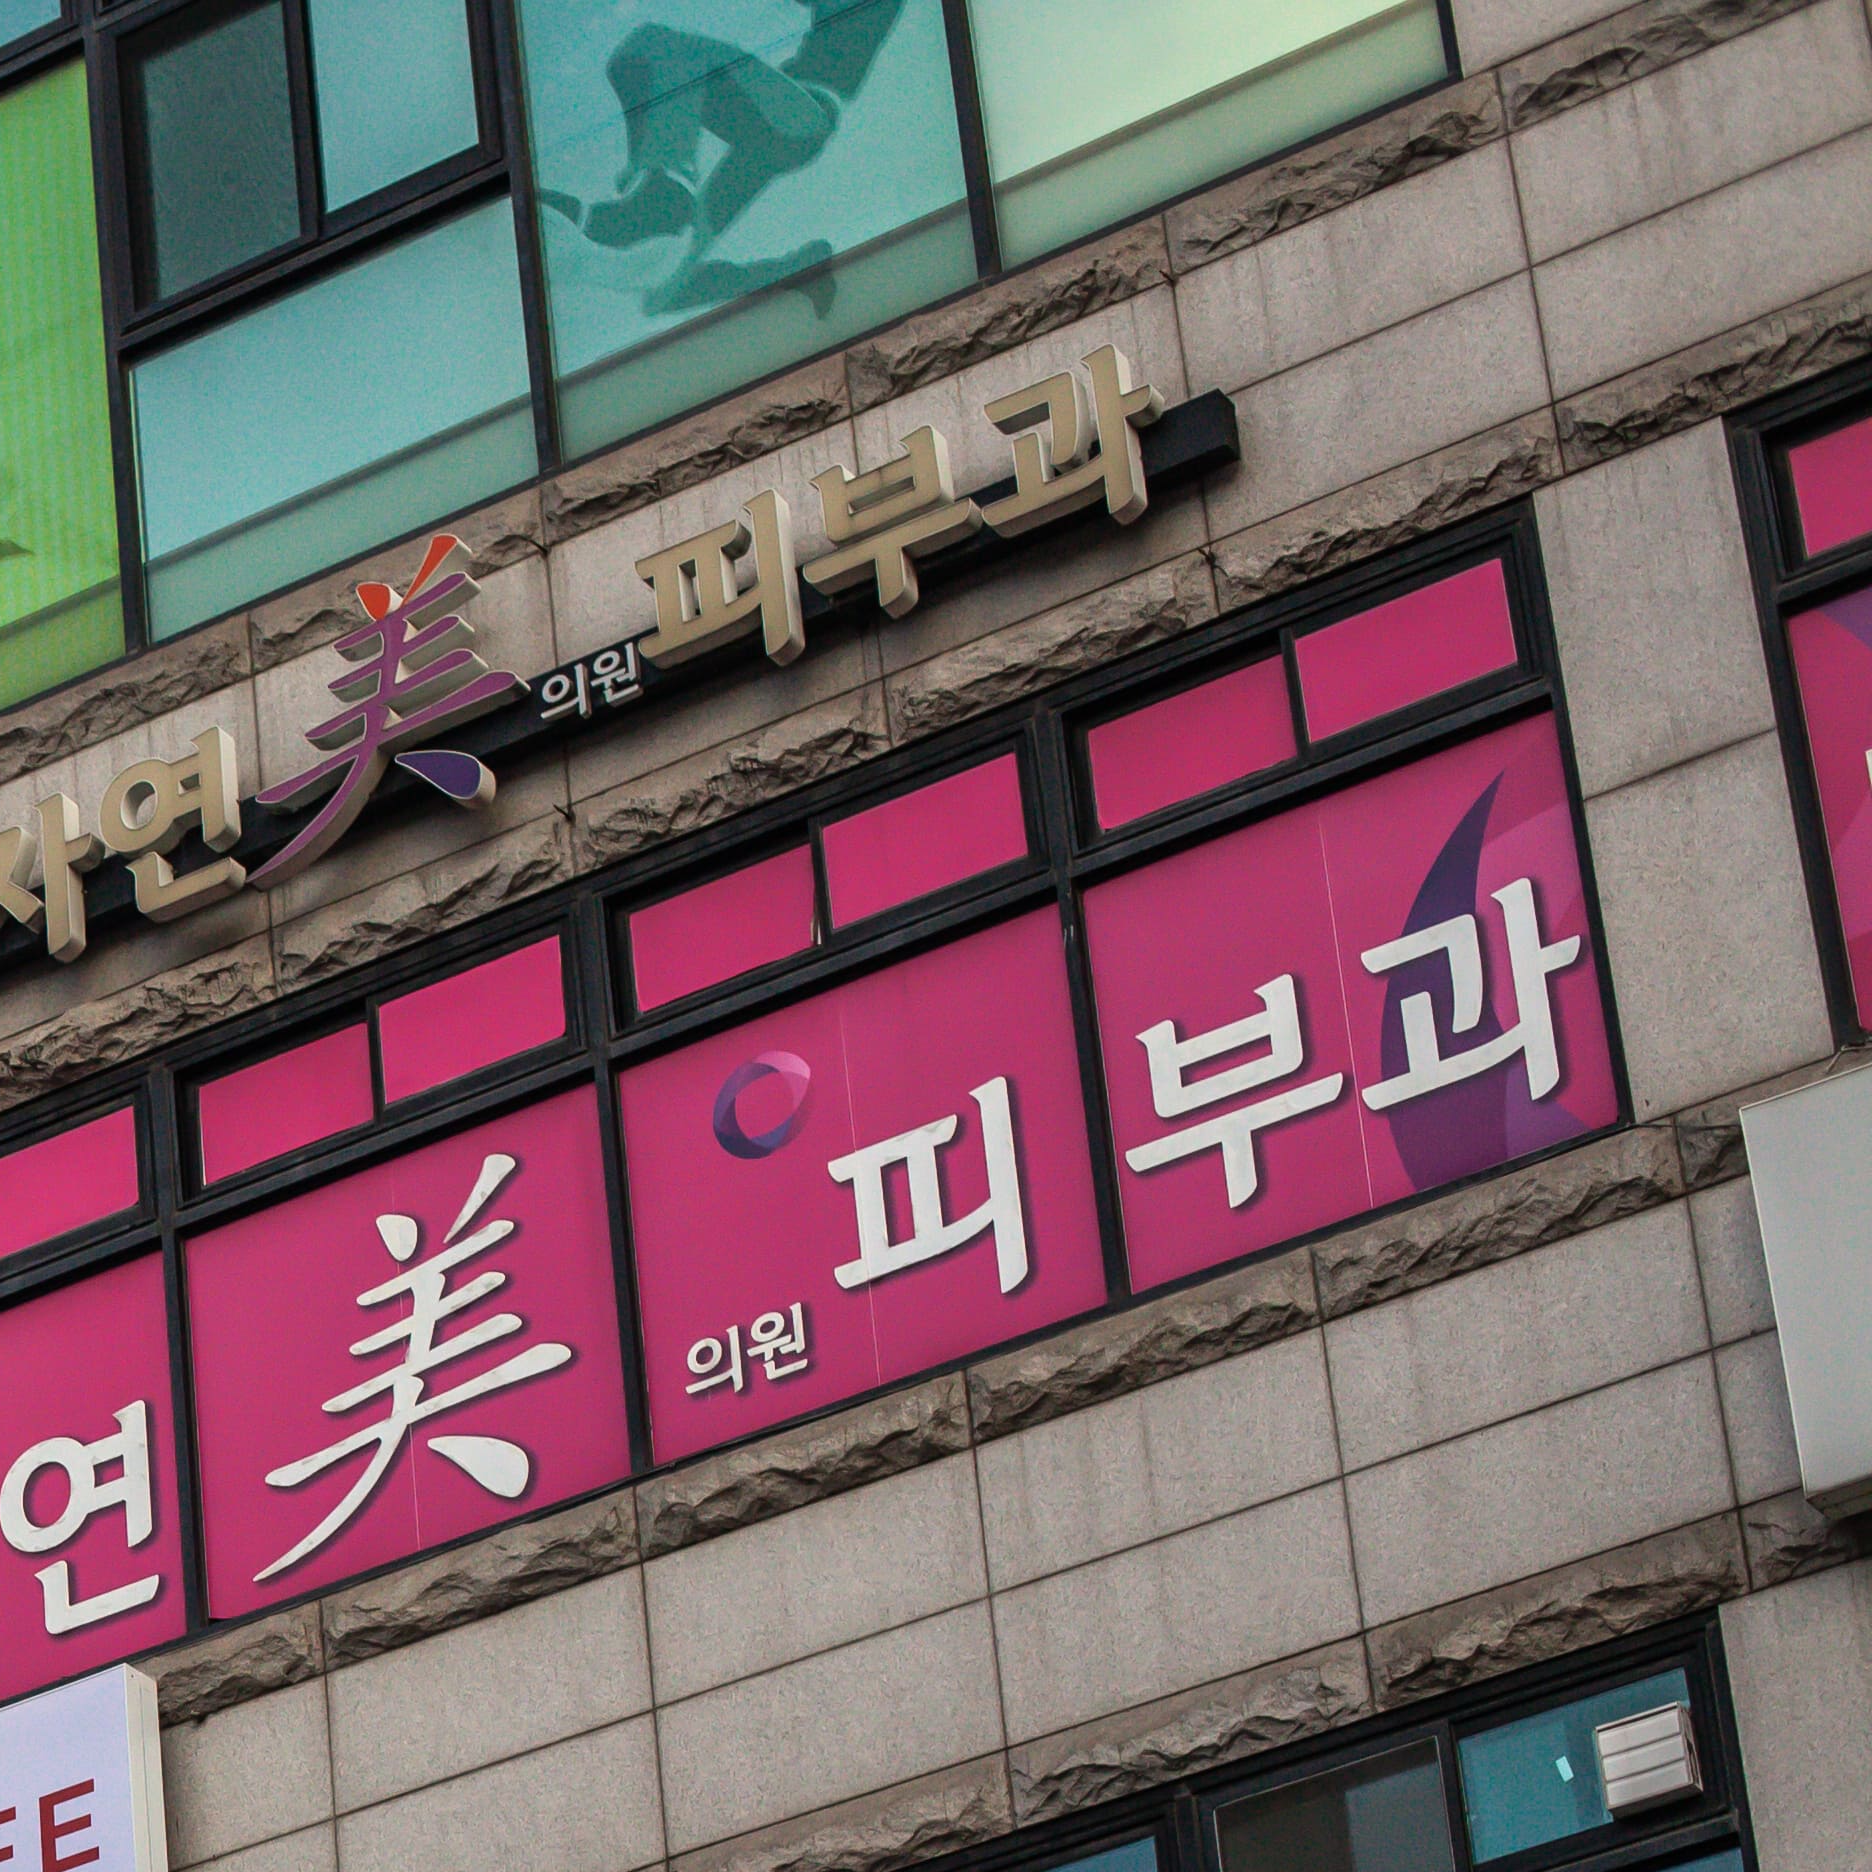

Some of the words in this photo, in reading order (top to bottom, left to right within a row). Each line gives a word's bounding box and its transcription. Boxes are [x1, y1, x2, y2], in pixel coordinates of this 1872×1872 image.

[539, 641, 643, 726] 의원
[635, 343, 1165, 669] 피부과
[684, 1301, 810, 1396] 의원
[826, 876, 1583, 1296] 피부과
